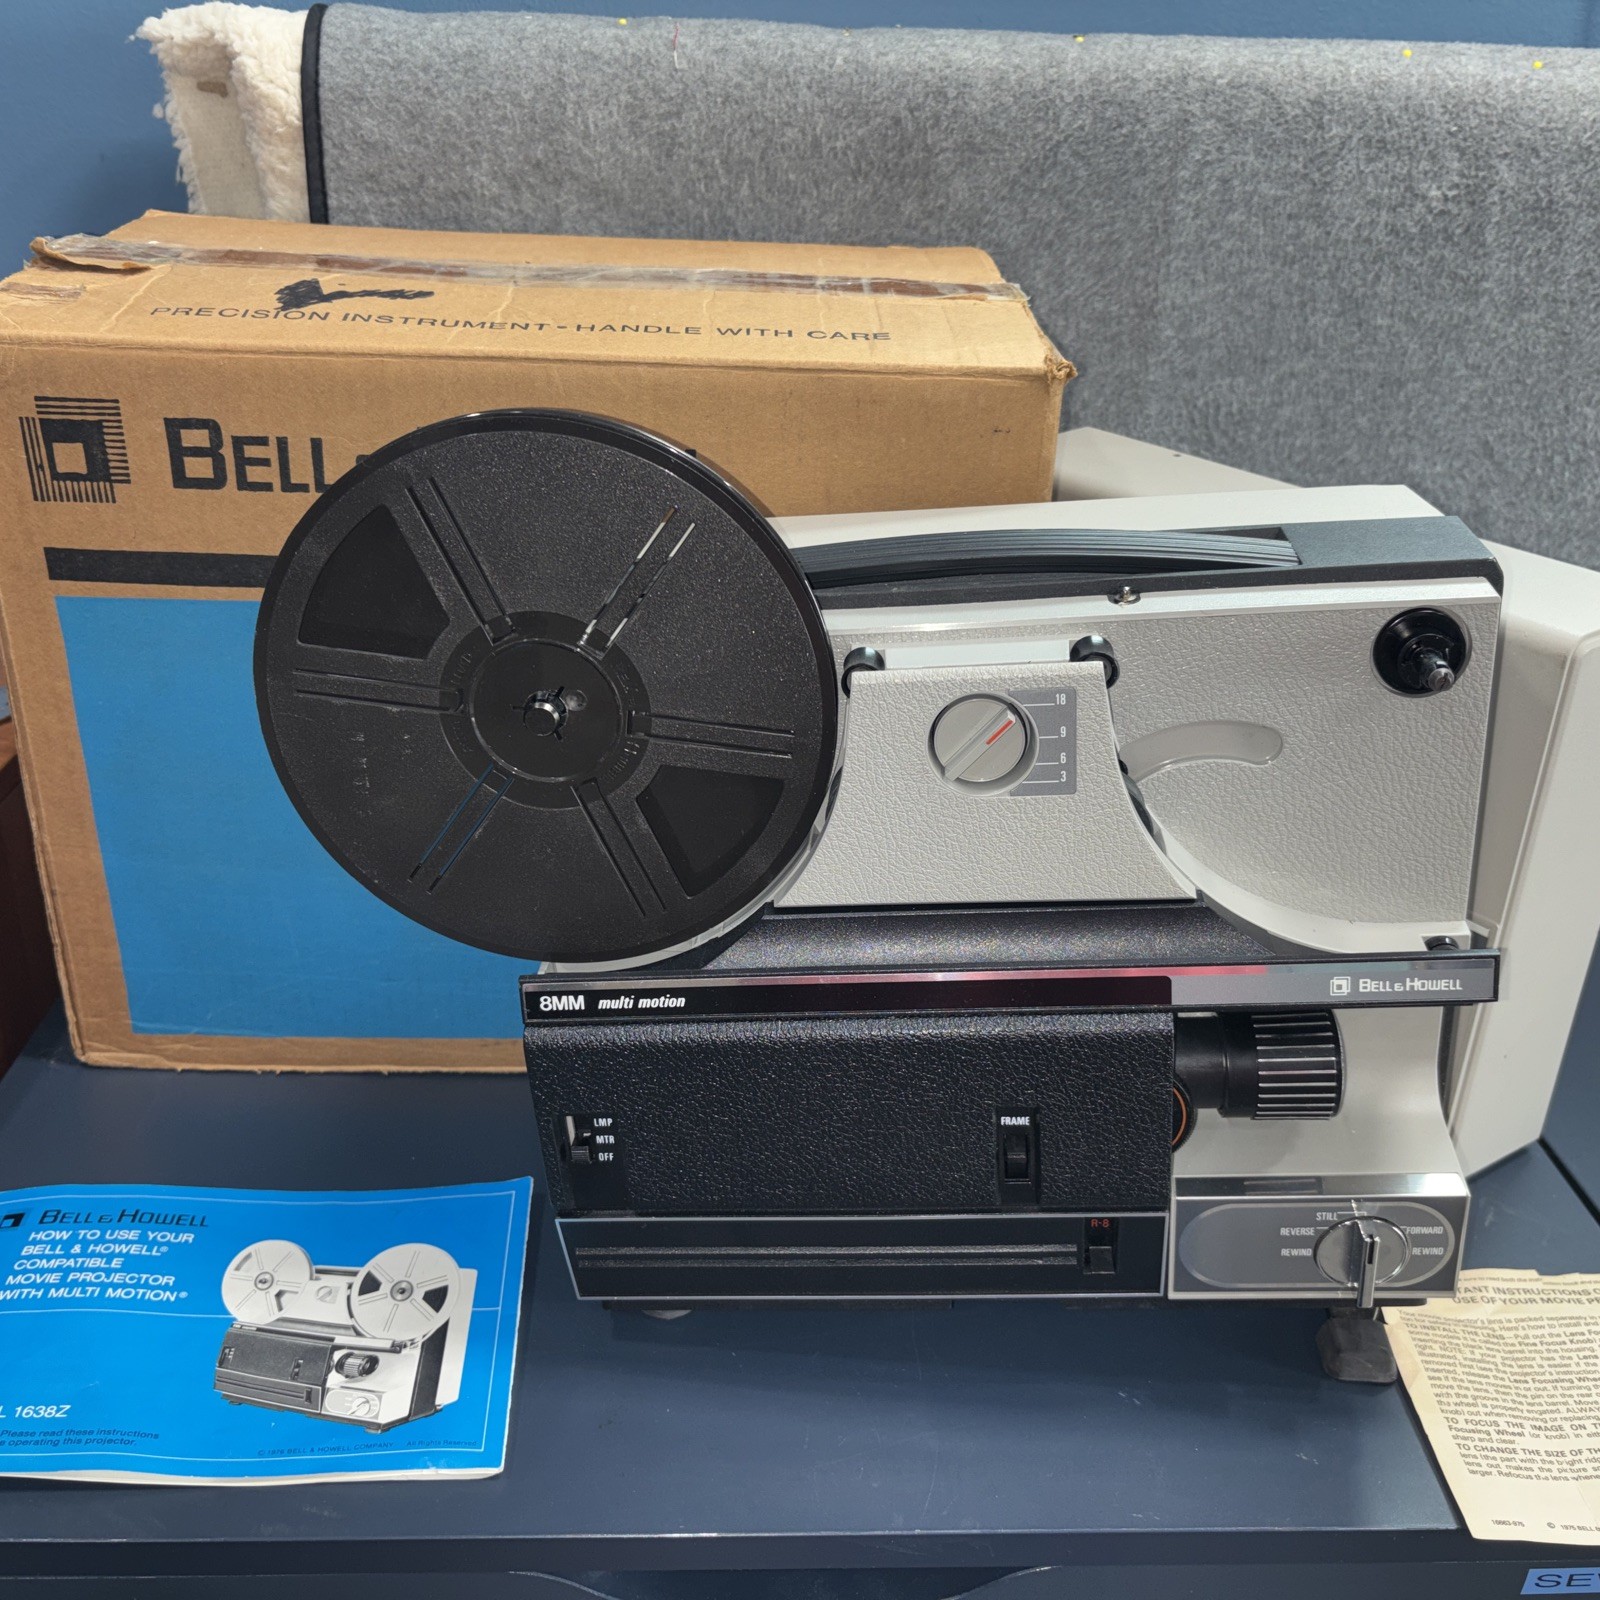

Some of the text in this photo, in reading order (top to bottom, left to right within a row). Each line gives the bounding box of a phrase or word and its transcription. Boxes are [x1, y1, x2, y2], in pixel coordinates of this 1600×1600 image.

[150, 306, 329, 321] PRECISION
[716, 327, 793, 338] WITH
[806, 330, 891, 341] CARE
[163, 417, 334, 494] BELL
[1055, 693, 1067, 706] 18
[1060, 726, 1067, 738] 9
[1060, 752, 1067, 764] 6
[1060, 770, 1067, 782] 3
[1359, 977, 1463, 993] BELL & HOWELL
[539, 995, 686, 1011] 8MM multi motion
[593, 1117, 613, 1127] LMP
[1000, 1116, 1030, 1126] FRAME
[596, 1135, 615, 1145] MTR
[598, 1152, 614, 1162] OFF
[38, 1208, 209, 1228] BELL & HOWELL
[1316, 1212, 1338, 1221] STILL
[28, 1229, 195, 1243] HOW TO USE YOUR
[1280, 1226, 1315, 1236] REVERSE
[1406, 1225, 1443, 1235] FORWARD
[21, 1244, 65, 1256] BELL
[70, 1243, 82, 1254] &
[1281, 1248, 1312, 1257] REWIND
[1412, 1247, 1444, 1256] REWIND
[13, 1257, 125, 1271] COMPATIBLE
[5, 1271, 176, 1287] MOVIE PROJECTOR
[0, 1288, 45, 1302] WITH
[47, 1286, 101, 1299] MULTI
[1491, 1286, 1591, 1297] INSTRUCTIONS
[1452, 1296, 1480, 1304] USE
[1480, 1295, 1498, 1305] OF
[1499, 1297, 1539, 1305] YOUR
[1540, 1297, 1586, 1305] MOVIE
[1539, 1339, 1568, 1348] Focus
[14, 1405, 72, 1418] 1638Z
[1443, 1416, 1587, 1432] TO FOCUS THE IMAGE ON
[38, 1428, 64, 1438] read
[65, 1428, 97, 1437] these
[97, 1428, 160, 1440] instructions
[1448, 1424, 1492, 1437] Focusing
[1493, 1428, 1527, 1438] Wheel
[8, 1438, 60, 1448] operating
[62, 1438, 83, 1446] this
[1451, 1433, 1476, 1443] sharp
[1477, 1436, 1495, 1444] and
[353, 1442, 394, 1451] COMPANY
[1455, 1442, 1471, 1451] TO
[1473, 1444, 1519, 1455] CHANGE
[1520, 1448, 1544, 1457] THE
[1544, 1449, 1568, 1458] SIZE
[1569, 1448, 1584, 1457] OF
[1459, 1451, 1479, 1460] lens
[1518, 1456, 1539, 1464] with
[1540, 1458, 1555, 1466] the
[1463, 1459, 1483, 1468] lens
[1486, 1462, 1502, 1470] out
[1505, 1464, 1535, 1472] makes
[1496, 1469, 1534, 1480] Refocus
